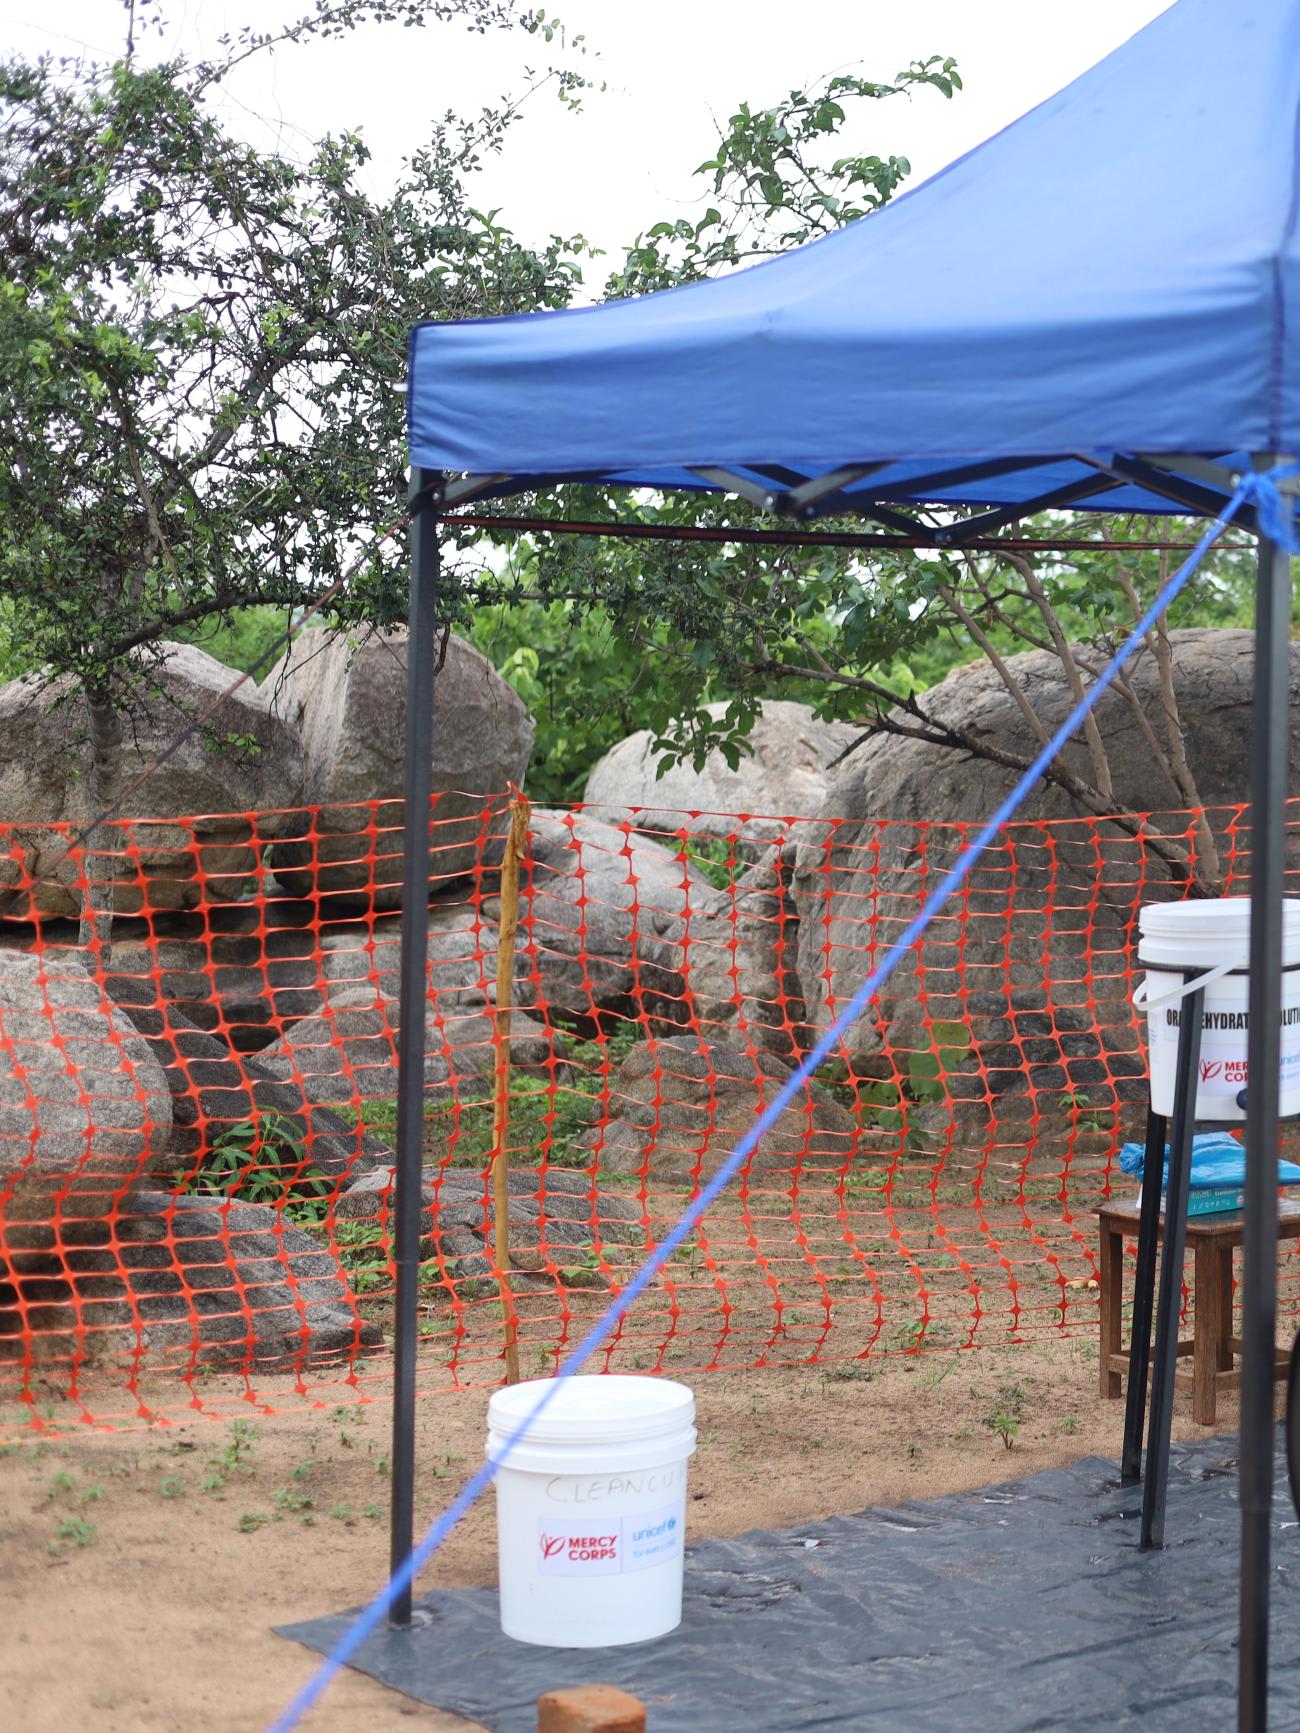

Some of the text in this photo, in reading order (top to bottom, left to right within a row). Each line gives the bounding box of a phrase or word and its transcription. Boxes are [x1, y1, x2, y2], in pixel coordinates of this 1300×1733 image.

[1225, 1061, 1249, 1071] MER
[633, 1519, 666, 1542] unicef
[568, 1535, 618, 1549] MERCY
[568, 1547, 617, 1561] CORPS
